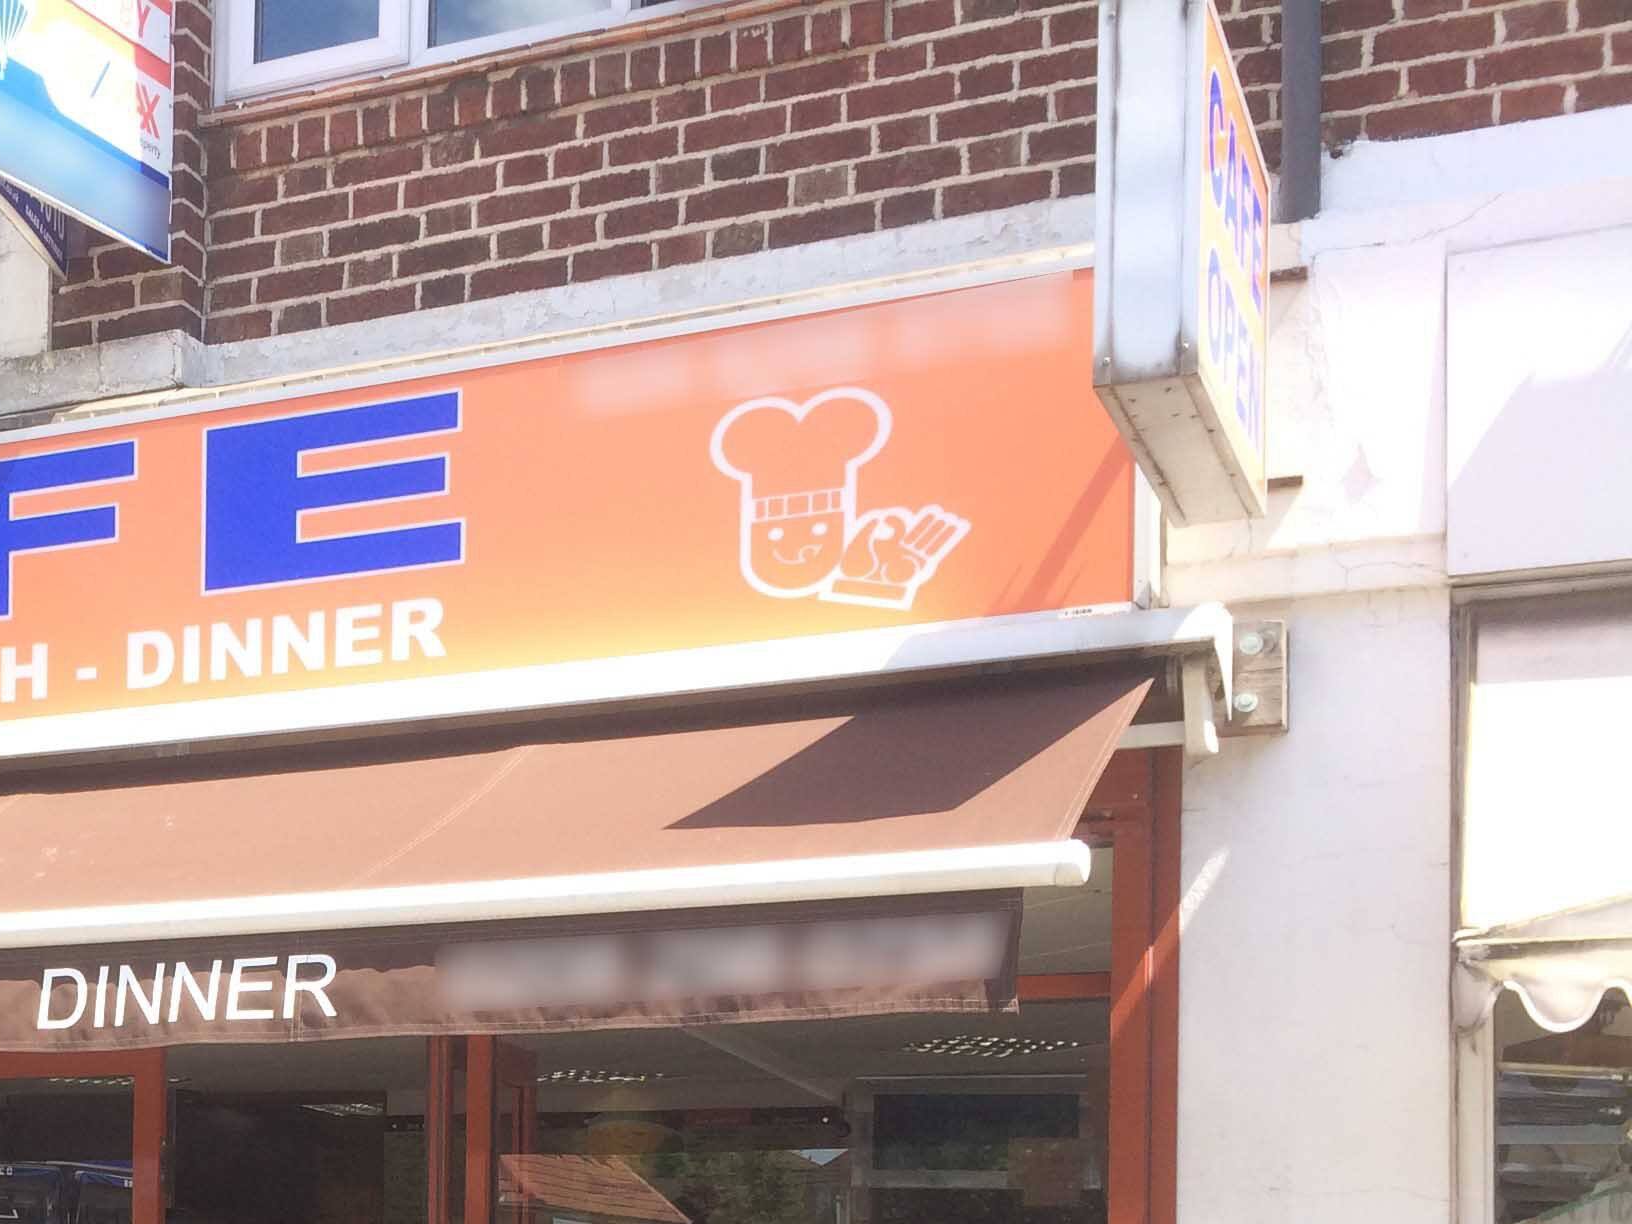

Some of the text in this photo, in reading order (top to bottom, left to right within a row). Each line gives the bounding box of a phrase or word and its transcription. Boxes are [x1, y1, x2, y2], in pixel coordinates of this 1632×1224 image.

[1207, 69, 1262, 312] CAFE
[1207, 247, 1261, 452] OPEN
[126, 598, 447, 690] DINNER
[35, 952, 338, 1032] DINNER
